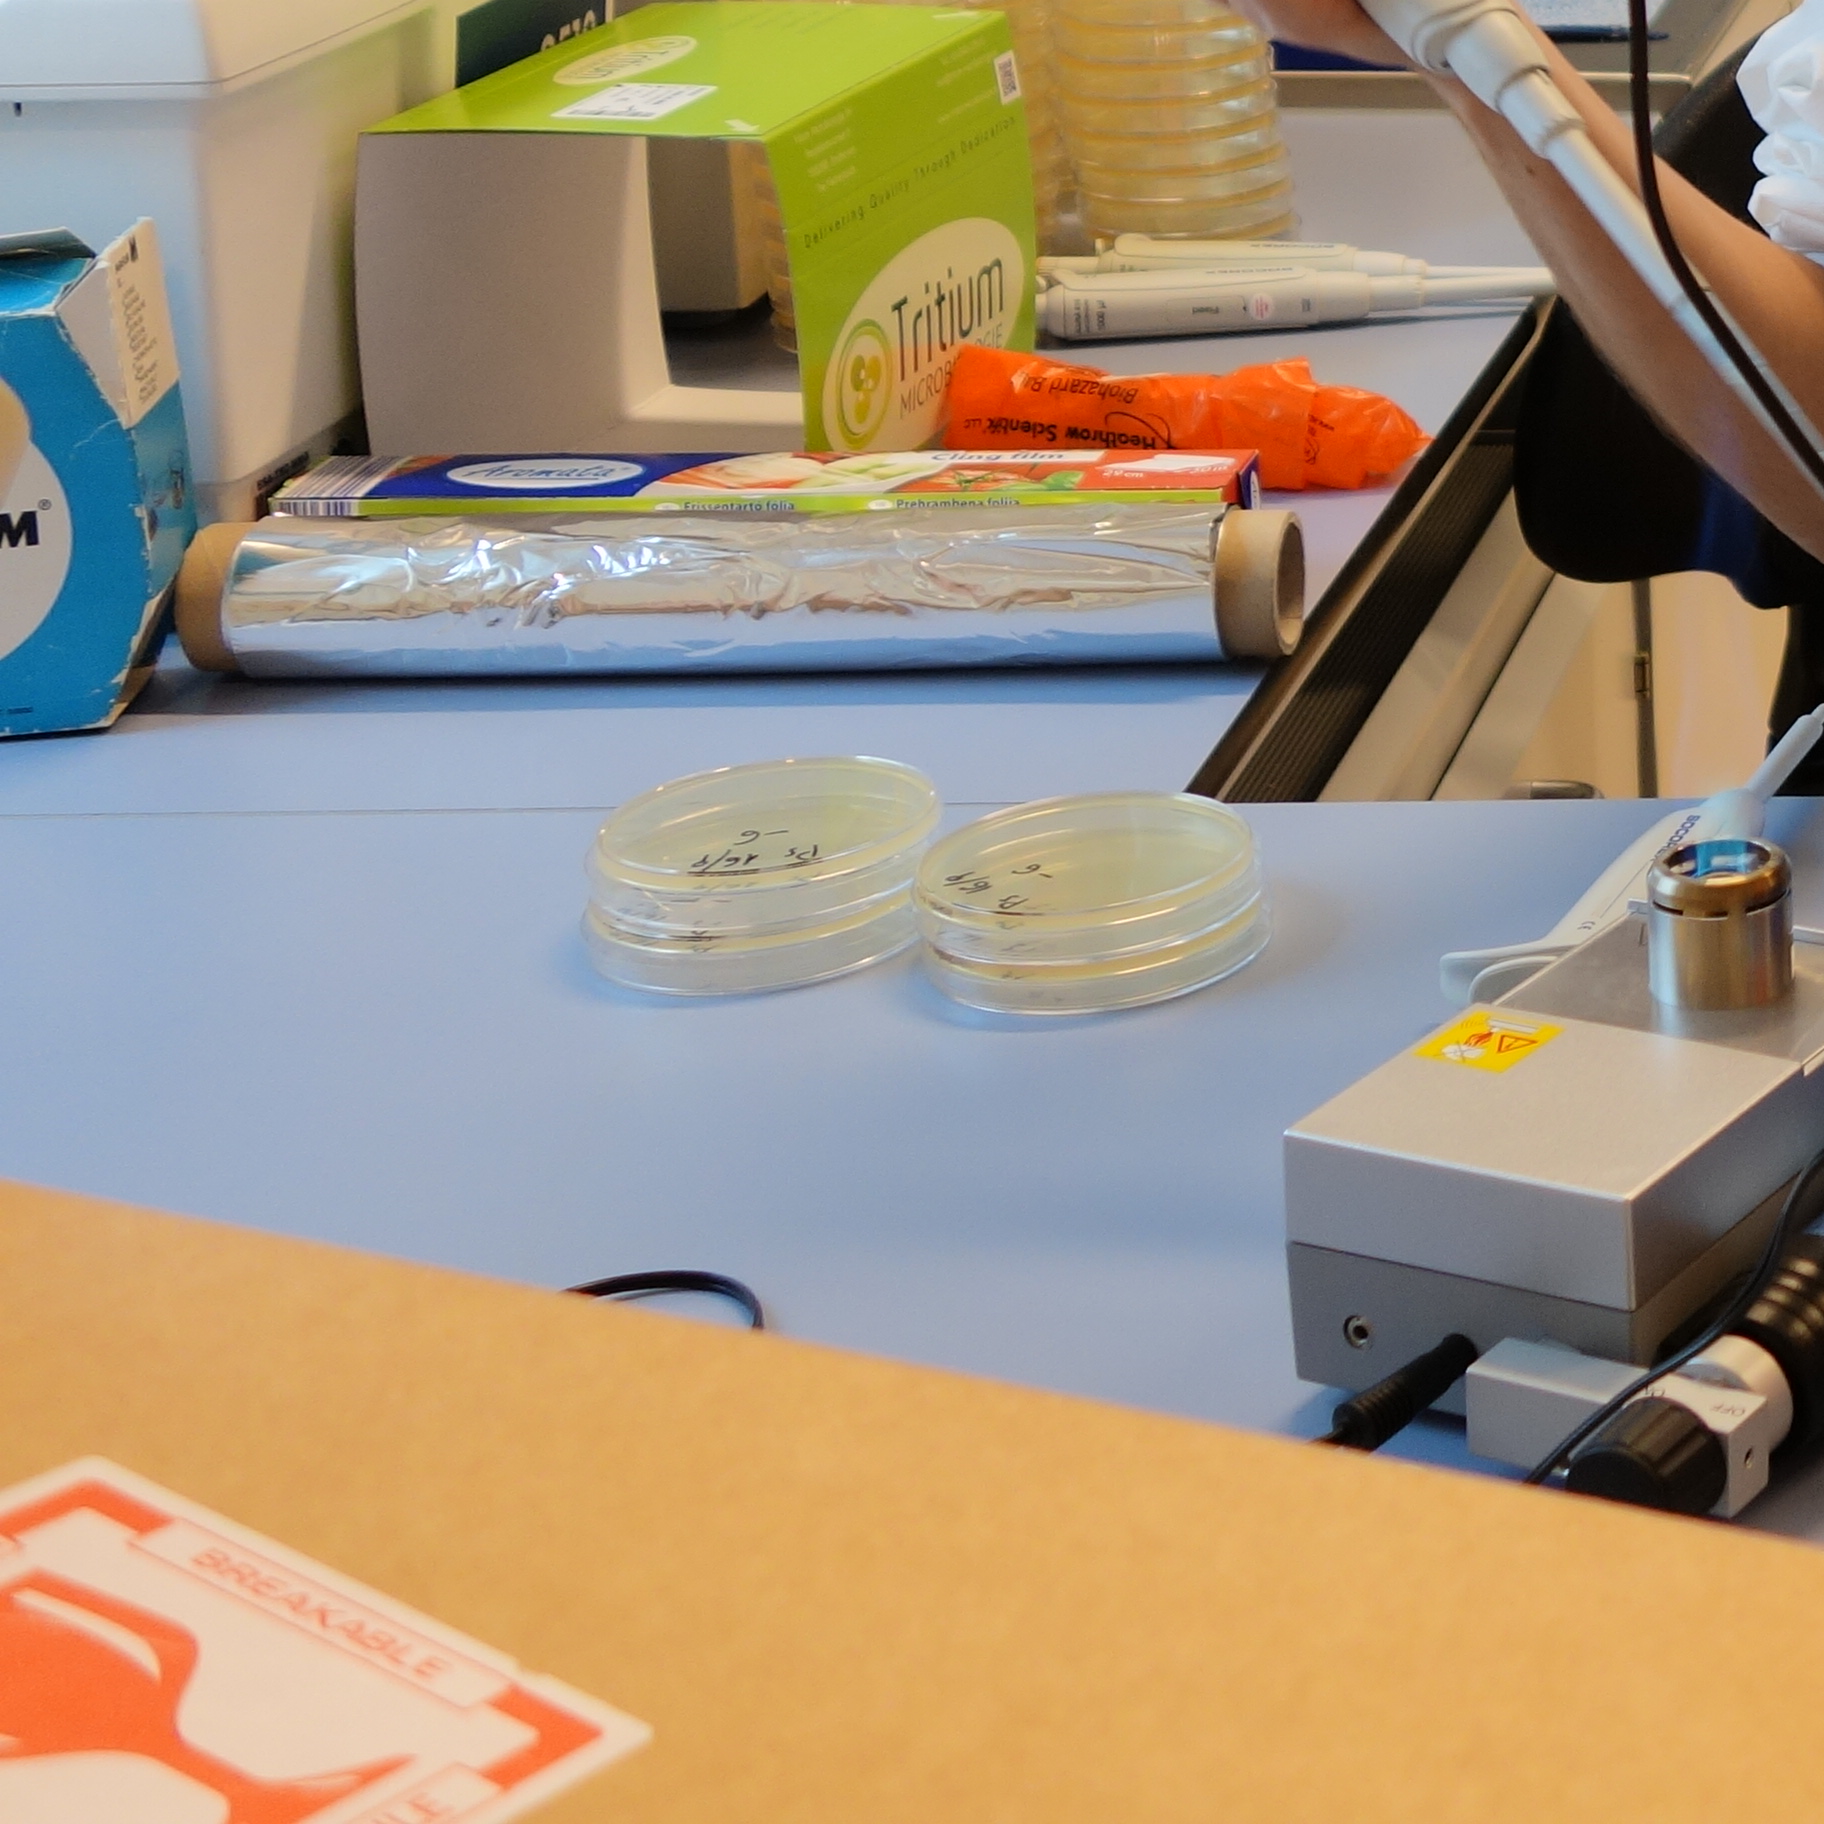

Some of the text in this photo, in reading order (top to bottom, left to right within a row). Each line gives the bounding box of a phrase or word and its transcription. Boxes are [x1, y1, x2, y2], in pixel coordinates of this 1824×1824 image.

[891, 256, 1004, 382] Tritium
[1050, 376, 1139, 405] Biohazard
[1065, 425, 1157, 449] Heathrow
[931, 450, 1065, 464] Cling film
[1711, 1403, 1747, 1417] OFF
[189, 1546, 454, 1680] BREAKABLE
